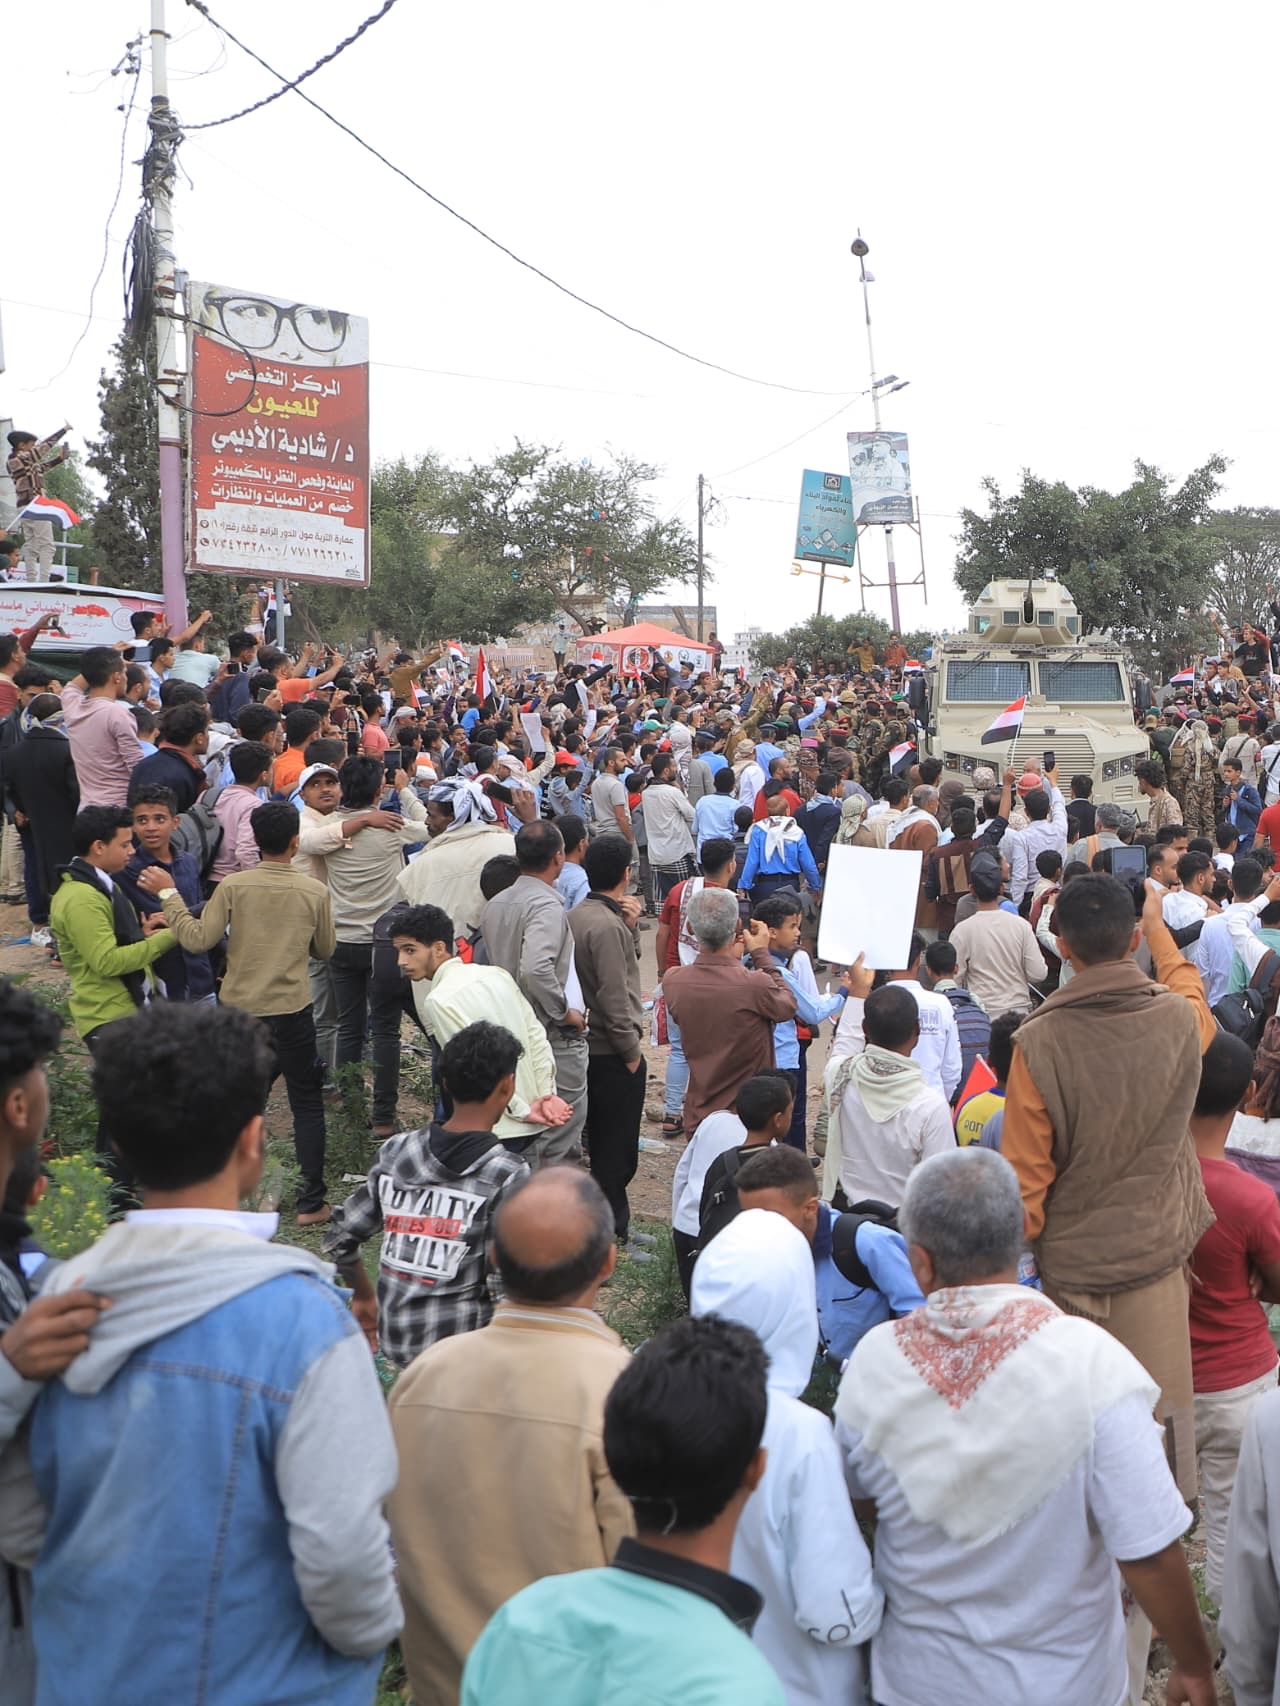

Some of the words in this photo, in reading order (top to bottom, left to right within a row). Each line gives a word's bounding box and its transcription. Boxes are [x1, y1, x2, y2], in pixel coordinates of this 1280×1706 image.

[224, 366, 288, 385] التخصصي
[289, 373, 340, 398] المركز
[245, 390, 320, 418] للعيون
[211, 418, 276, 453] الأديمي
[277, 427, 327, 461] شادية
[211, 460, 272, 484] بالكمبيوتر
[273, 467, 297, 485] النظر
[298, 473, 327, 491] وفحص
[327, 474, 354, 493] المعاينة
[210, 482, 262, 505] والنظارات
[264, 490, 307, 508] العمليات
[308, 497, 324, 512] من
[328, 500, 354, 514] خصم
